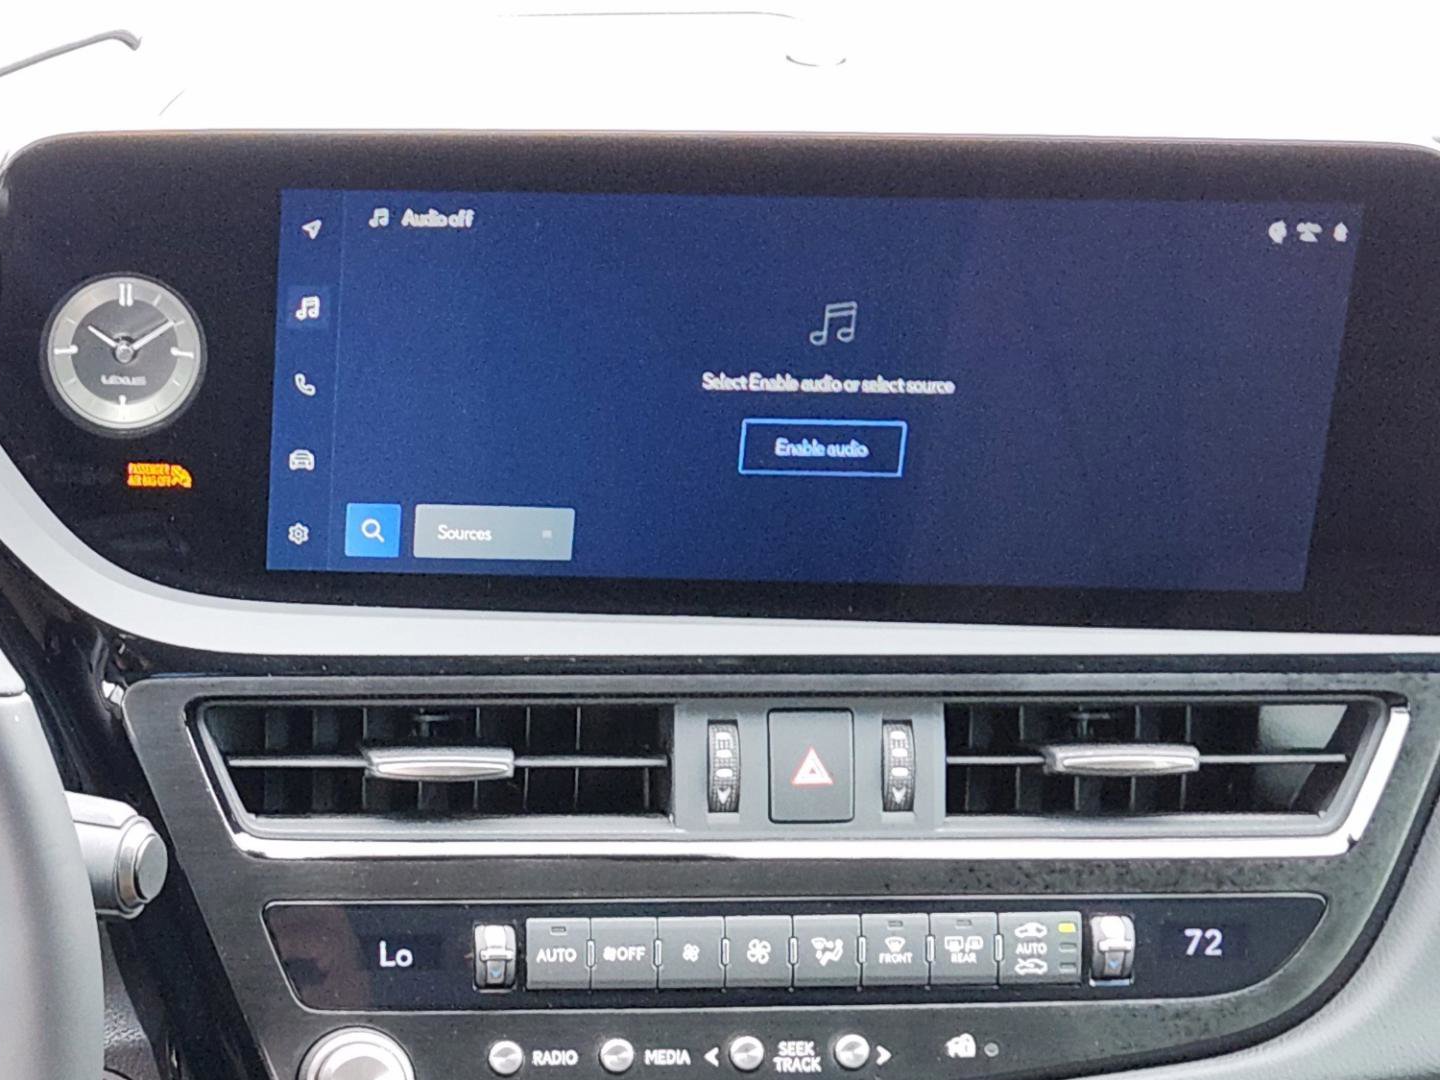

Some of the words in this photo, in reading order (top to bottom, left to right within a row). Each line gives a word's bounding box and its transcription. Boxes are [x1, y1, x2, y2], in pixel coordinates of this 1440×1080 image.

[400, 207, 448, 228] Audio
[448, 208, 476, 229] off
[701, 371, 748, 392] Select
[748, 371, 800, 393] Enable
[800, 374, 843, 393] audio
[843, 379, 861, 393] or
[861, 375, 906, 394] select
[906, 379, 957, 395] source
[774, 437, 826, 457] Enable
[826, 439, 870, 458] audio
[437, 524, 493, 543] Sources
[1015, 942, 1048, 955] AUTO
[1184, 927, 1223, 957] 72
[378, 940, 414, 968] Lo
[535, 947, 578, 963] AUTO
[616, 946, 646, 961] OFF
[878, 951, 913, 965] FRONT
[777, 1040, 816, 1057] SEEK
[531, 1049, 579, 1067] RADIO
[644, 1049, 691, 1067] MEDIA
[773, 1056, 822, 1074] TRACK
